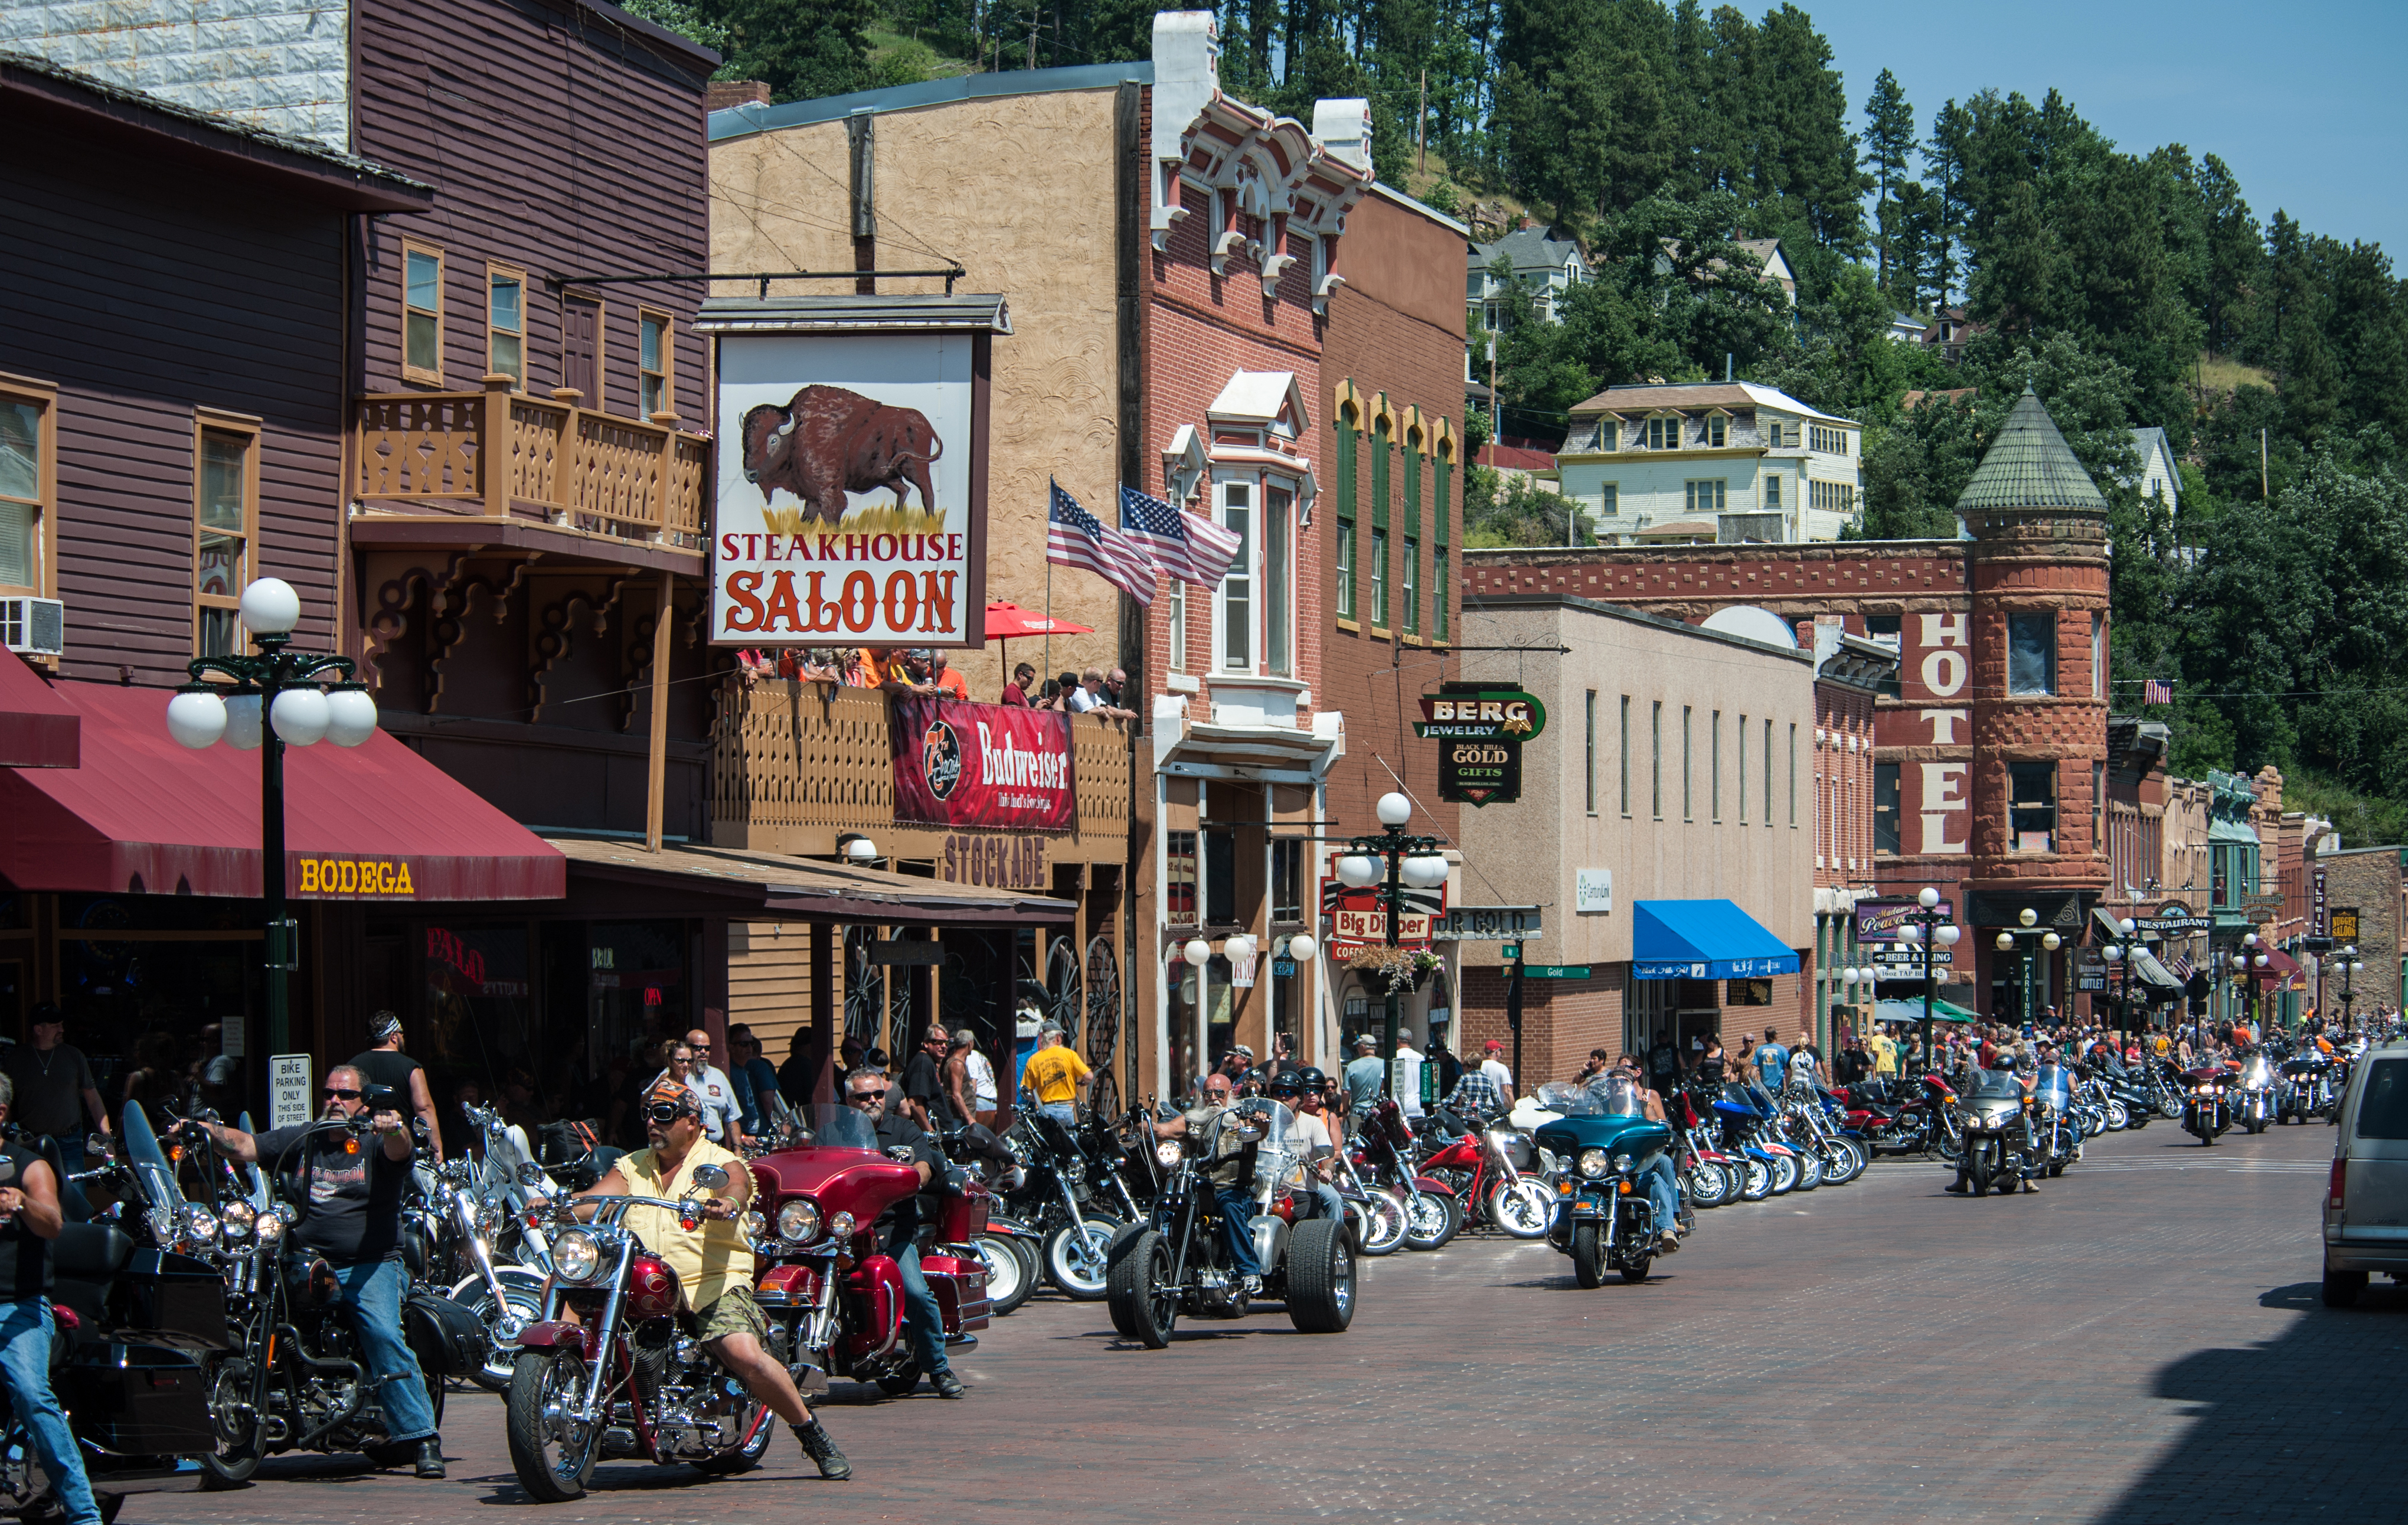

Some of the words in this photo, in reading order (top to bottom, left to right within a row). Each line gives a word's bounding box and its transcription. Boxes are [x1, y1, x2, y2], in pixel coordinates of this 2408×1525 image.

[721, 533, 963, 561] STEAKHOUSE
[724, 570, 958, 634] SALOON
[1433, 701, 1528, 721] BERG
[1423, 726, 1496, 737] JEWELRY
[1919, 613, 1969, 854] HOTEL
[976, 721, 1067, 789] Budweiser
[1452, 750, 1508, 763] GOLD
[1458, 768, 1502, 776] GIFTS
[945, 834, 1044, 888] STOCKADE
[300, 859, 414, 893] BODEGA
[1587, 883, 1610, 902] CenturyLink
[2315, 873, 2324, 903] WILD
[1875, 906, 1912, 920] Madame
[1341, 913, 1365, 936] Big
[1370, 914, 1424, 938] Diper
[2138, 918, 2210, 929] RESTAURANT
[2315, 906, 2324, 935] BILL
[2332, 917, 2357, 928] NUGGET
[2332, 925, 2356, 937] SALOON
[1279, 943, 1290, 958] ICE
[1884, 953, 1909, 962] BEER
[1273, 962, 1295, 976] CREAM
[1547, 967, 1563, 977] Gold
[2078, 964, 2106, 974] DEADWOOD
[1729, 979, 1747, 988] BLACK
[2079, 978, 2105, 990] OUTLET
[1730, 988, 1747, 996] HILLS
[1731, 997, 1745, 1005] GOLD
[1370, 1004, 1404, 1019] KNIVS
[281, 1064, 300, 1074] BIKE
[276, 1076, 306, 1088] PARKING
[282, 1090, 300, 1101] ONLY
[286, 1113, 306, 1122] STREET
